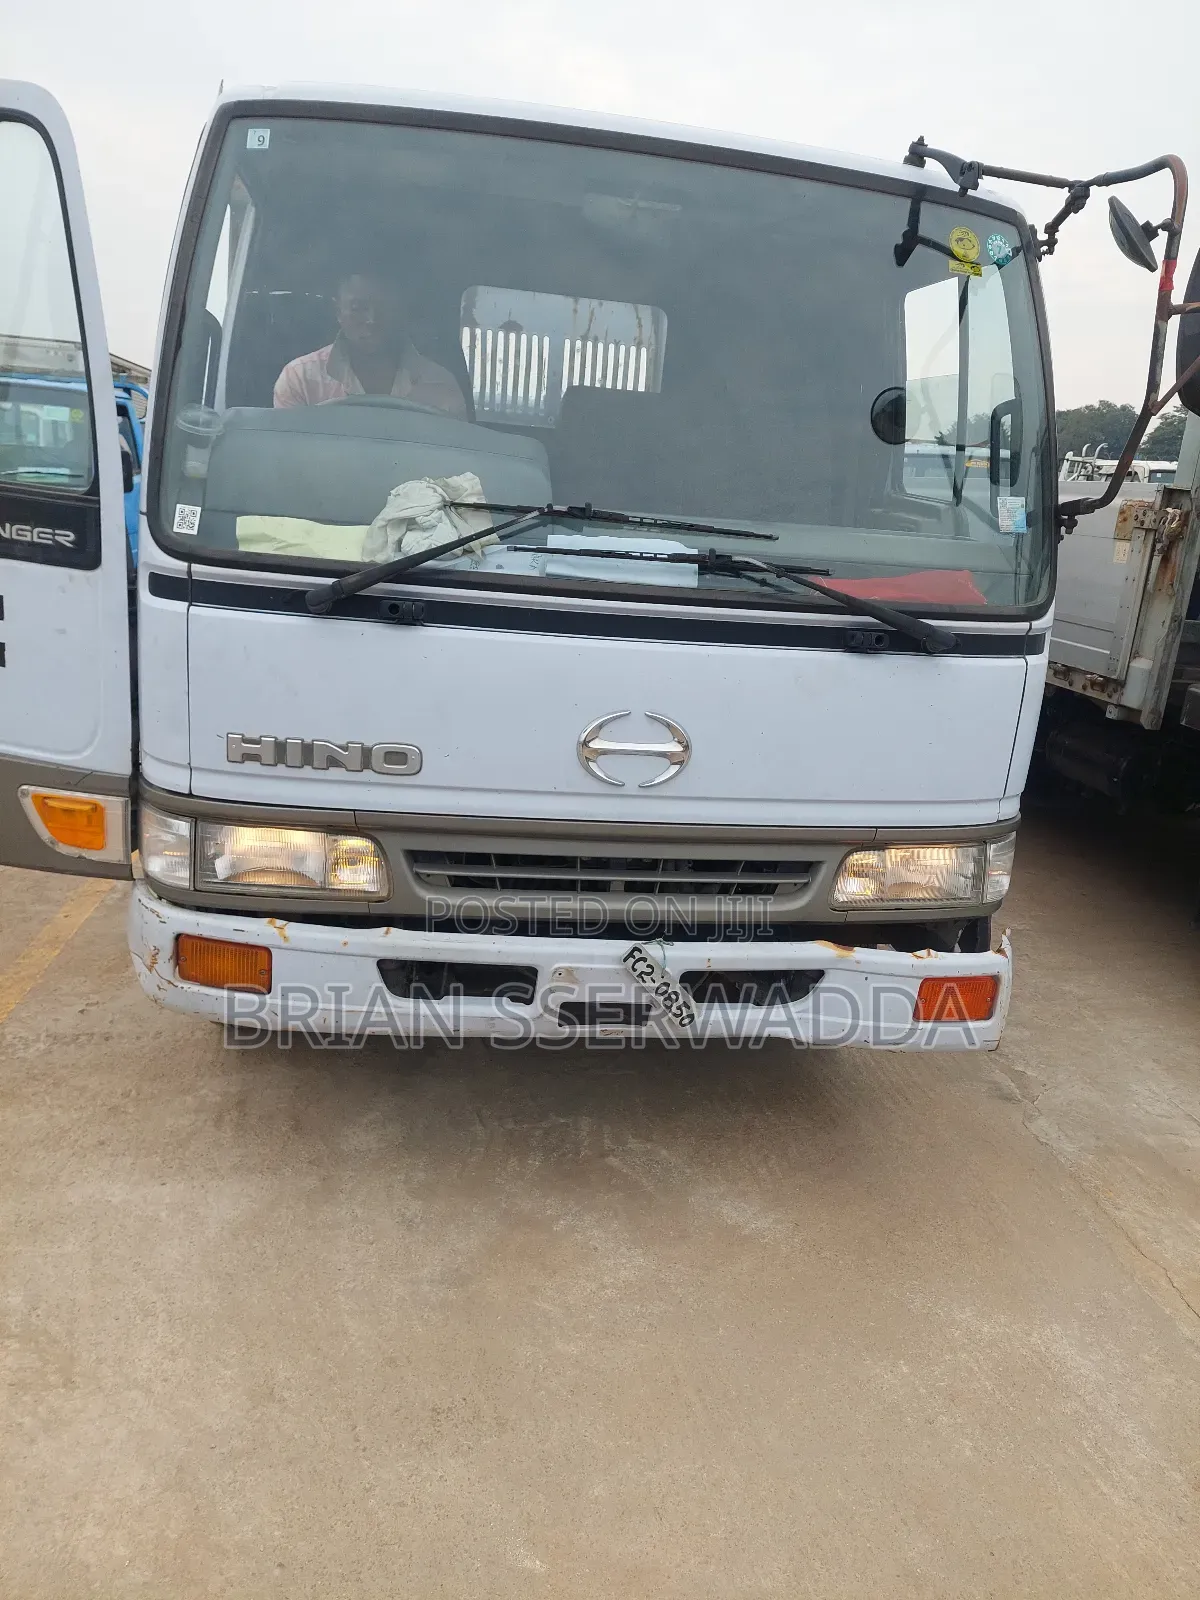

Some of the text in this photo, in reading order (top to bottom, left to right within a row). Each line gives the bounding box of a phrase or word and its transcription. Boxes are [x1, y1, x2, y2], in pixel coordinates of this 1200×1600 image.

[257, 134, 265, 146] 9
[226, 732, 423, 776] HINO
[622, 946, 695, 1028] FC2-0850
